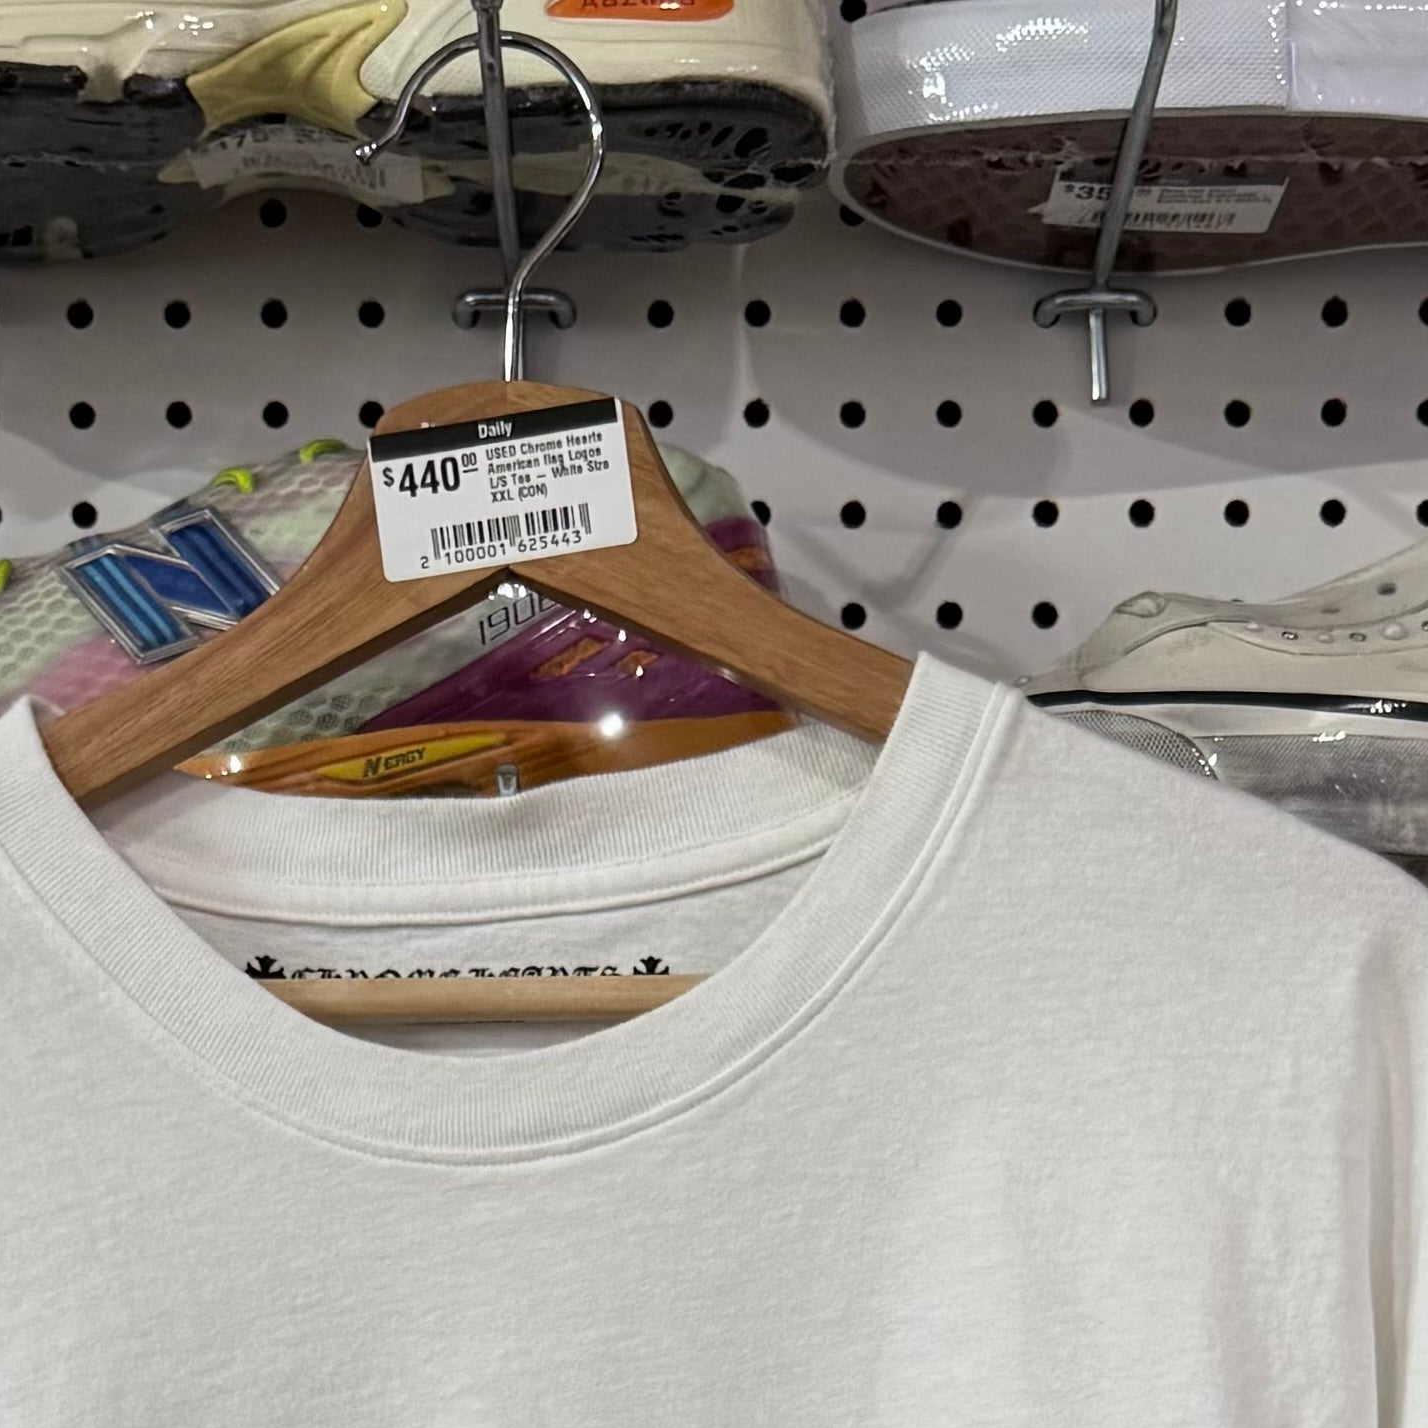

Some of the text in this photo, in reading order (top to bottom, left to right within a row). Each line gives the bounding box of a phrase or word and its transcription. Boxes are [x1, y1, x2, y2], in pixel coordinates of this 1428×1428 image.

[478, 421, 513, 439] Daily
[486, 432, 602, 461] USED Chrome Hearts
[487, 457, 540, 475] American
[490, 483, 548, 503] XXL (CON)
[420, 530, 582, 569] 2 100001 625443
